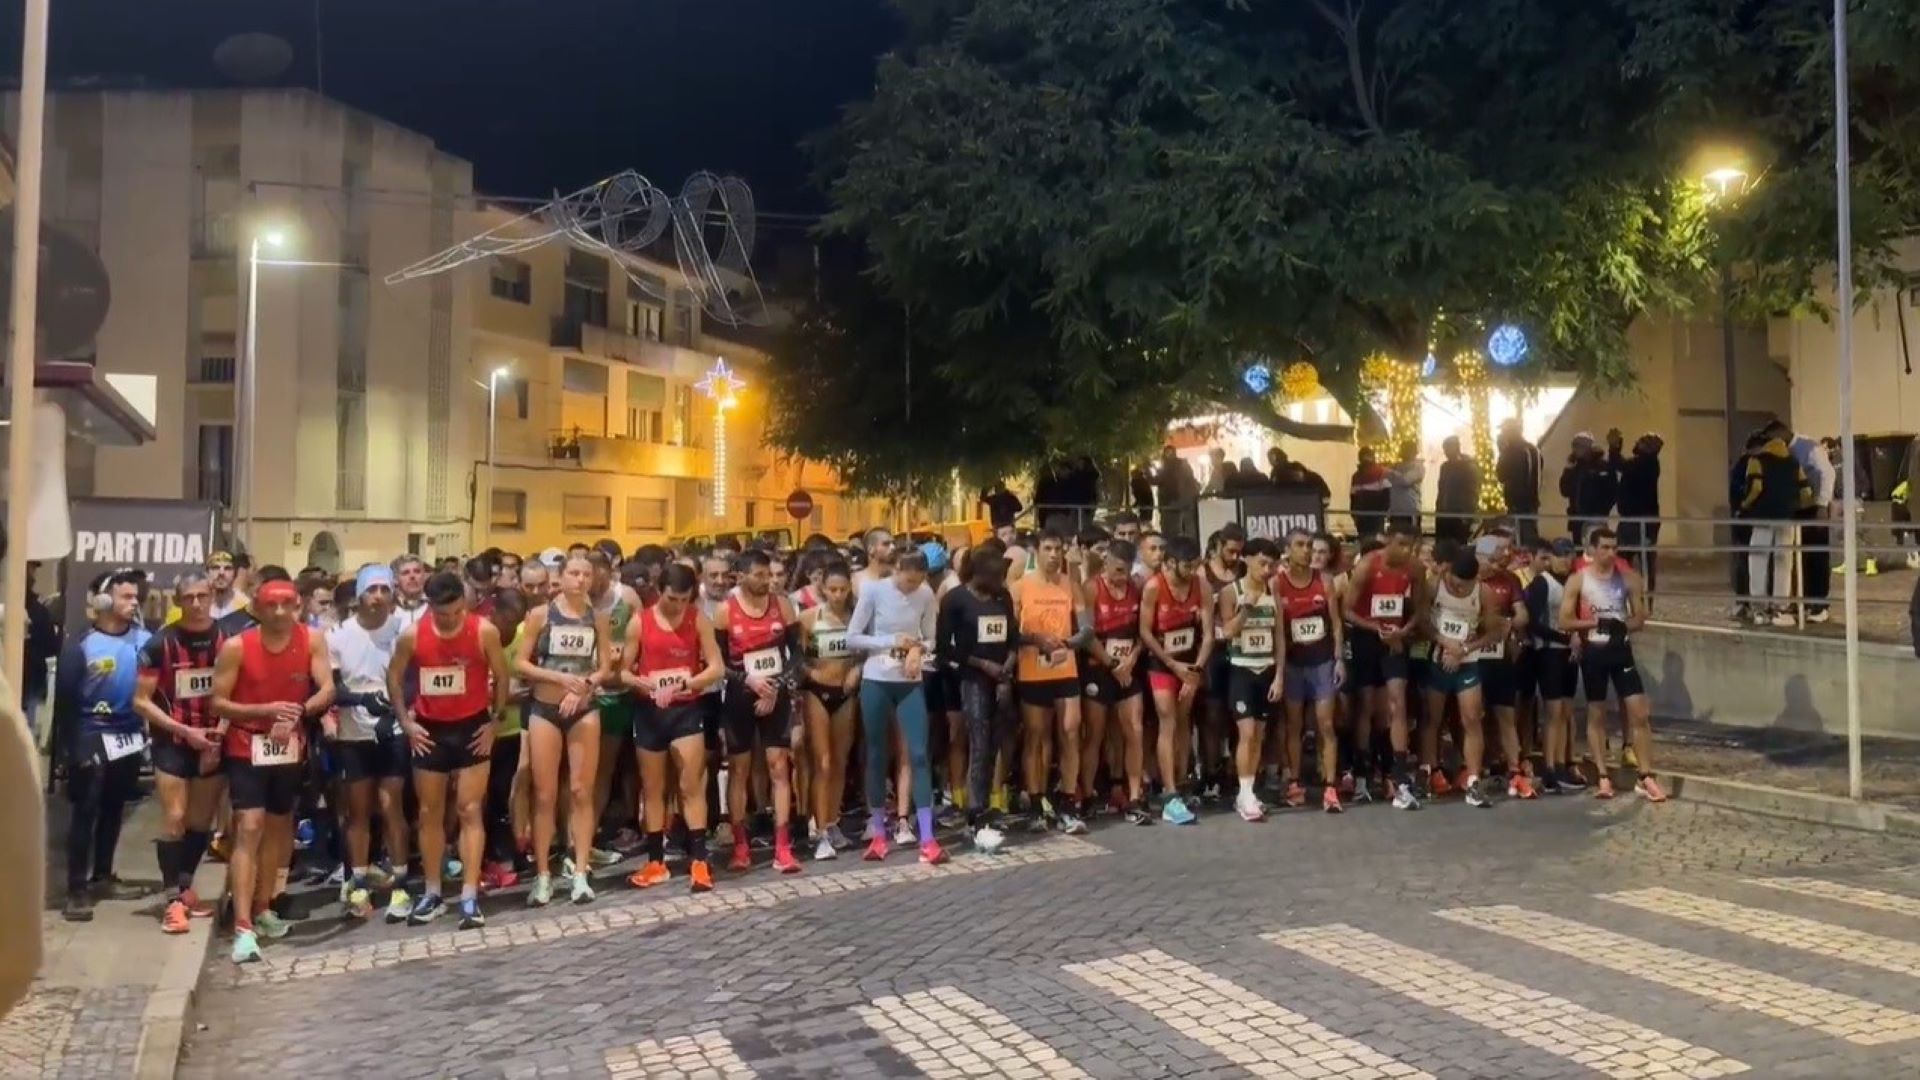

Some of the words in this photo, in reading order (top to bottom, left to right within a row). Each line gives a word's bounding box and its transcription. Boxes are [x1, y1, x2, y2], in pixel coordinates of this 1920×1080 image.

[1247, 514, 1318, 541] PARTIDA
[76, 531, 205, 563] PARTIDA
[560, 634, 584, 648] 328
[432, 674, 455, 688] 417
[263, 742, 289, 756] 302
